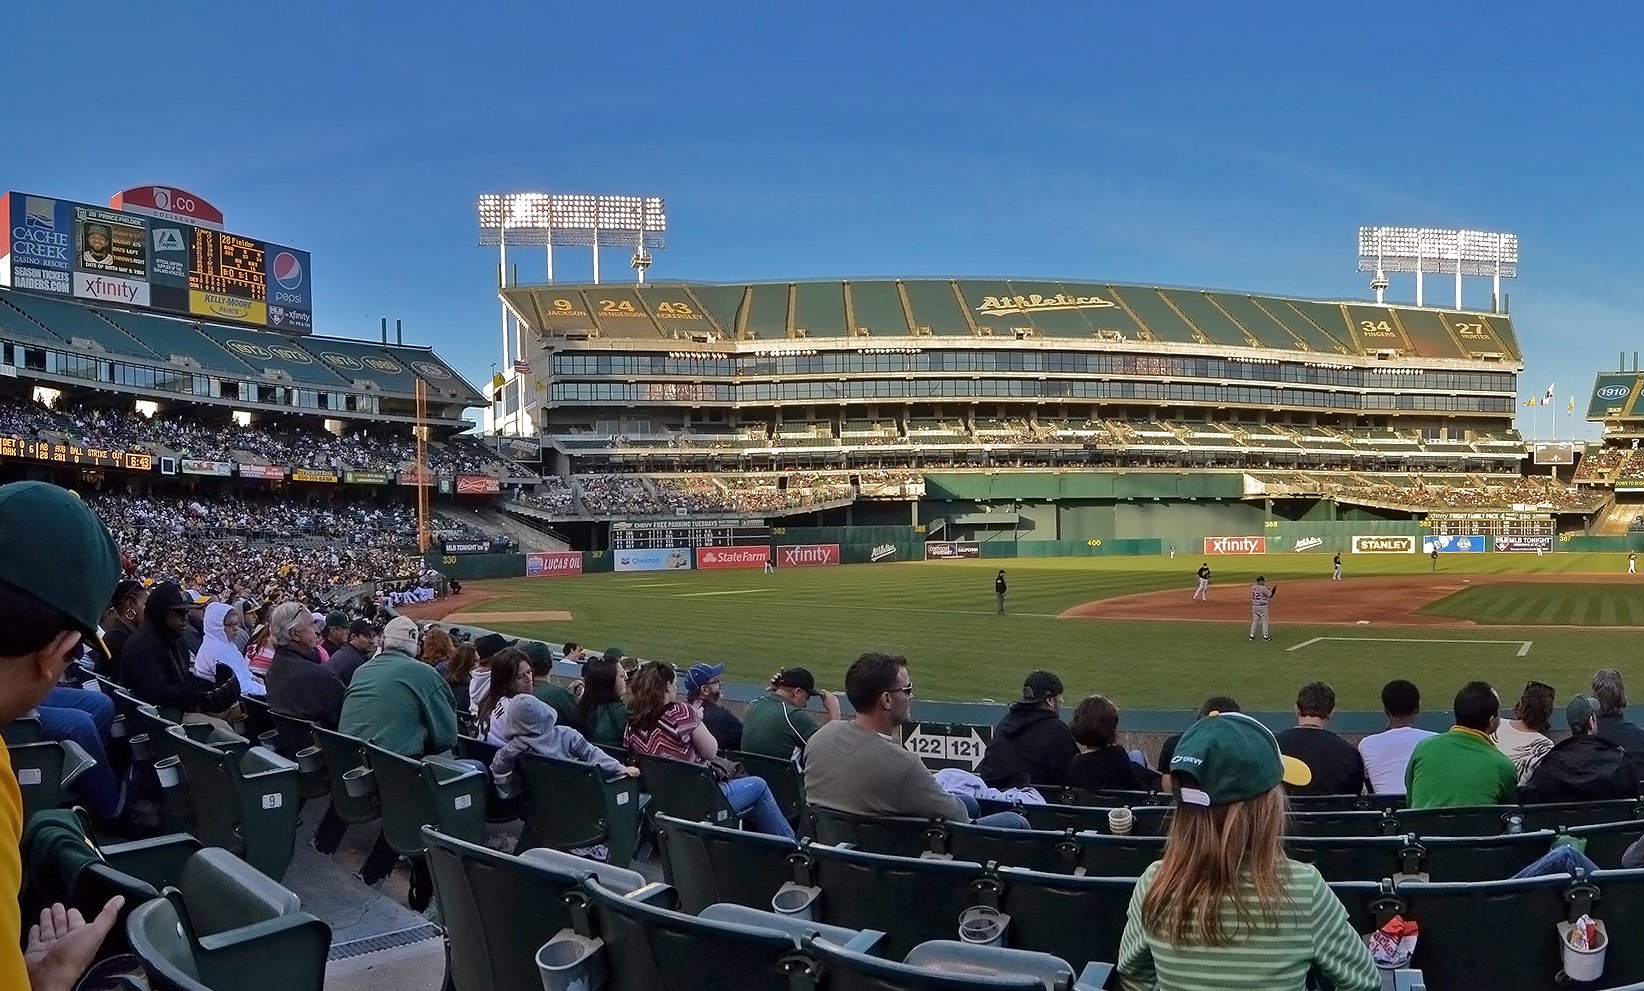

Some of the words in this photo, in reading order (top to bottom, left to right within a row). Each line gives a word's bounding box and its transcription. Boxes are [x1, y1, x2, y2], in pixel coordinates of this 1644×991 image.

[154, 211, 196, 224] COLISEUM
[12, 227, 69, 247] CACHE
[13, 241, 69, 260] CREEK
[13, 256, 40, 264] CASINO
[43, 260, 69, 269] RESORT
[14, 266, 41, 278] SEASON
[42, 270, 70, 282] TICKETS
[14, 276, 70, 294] RAIDERS.COM
[85, 277, 138, 302] xfinity
[205, 294, 252, 309] KELLY-MOORE
[275, 291, 302, 304] pepsi
[219, 307, 238, 315] PAINTS
[554, 300, 572, 311] 9
[600, 300, 635, 312] 24
[658, 302, 693, 314] 43
[976, 294, 1115, 316] Athletics
[1361, 320, 1391, 332] 34
[1455, 323, 1483, 334] 27
[230, 342, 268, 357] 1972
[1601, 388, 1627, 397] 1910
[2, 447, 16, 456] OAK
[3, 438, 16, 448] DET
[70, 446, 83, 455] BALL
[88, 449, 107, 459] STRIKE
[112, 452, 123, 460] OUT
[130, 457, 149, 469] 6:43
[1213, 537, 1258, 554] xfinity
[1360, 540, 1408, 550] STANLEY
[443, 556, 456, 564] 330
[543, 557, 568, 570] LUCAS
[569, 554, 581, 568] OIL
[785, 546, 831, 566] xfinity
[1252, 592, 1260, 600] 22
[909, 737, 941, 755] 122
[950, 739, 980, 757] 121
[1182, 755, 1203, 765] CHEVY
